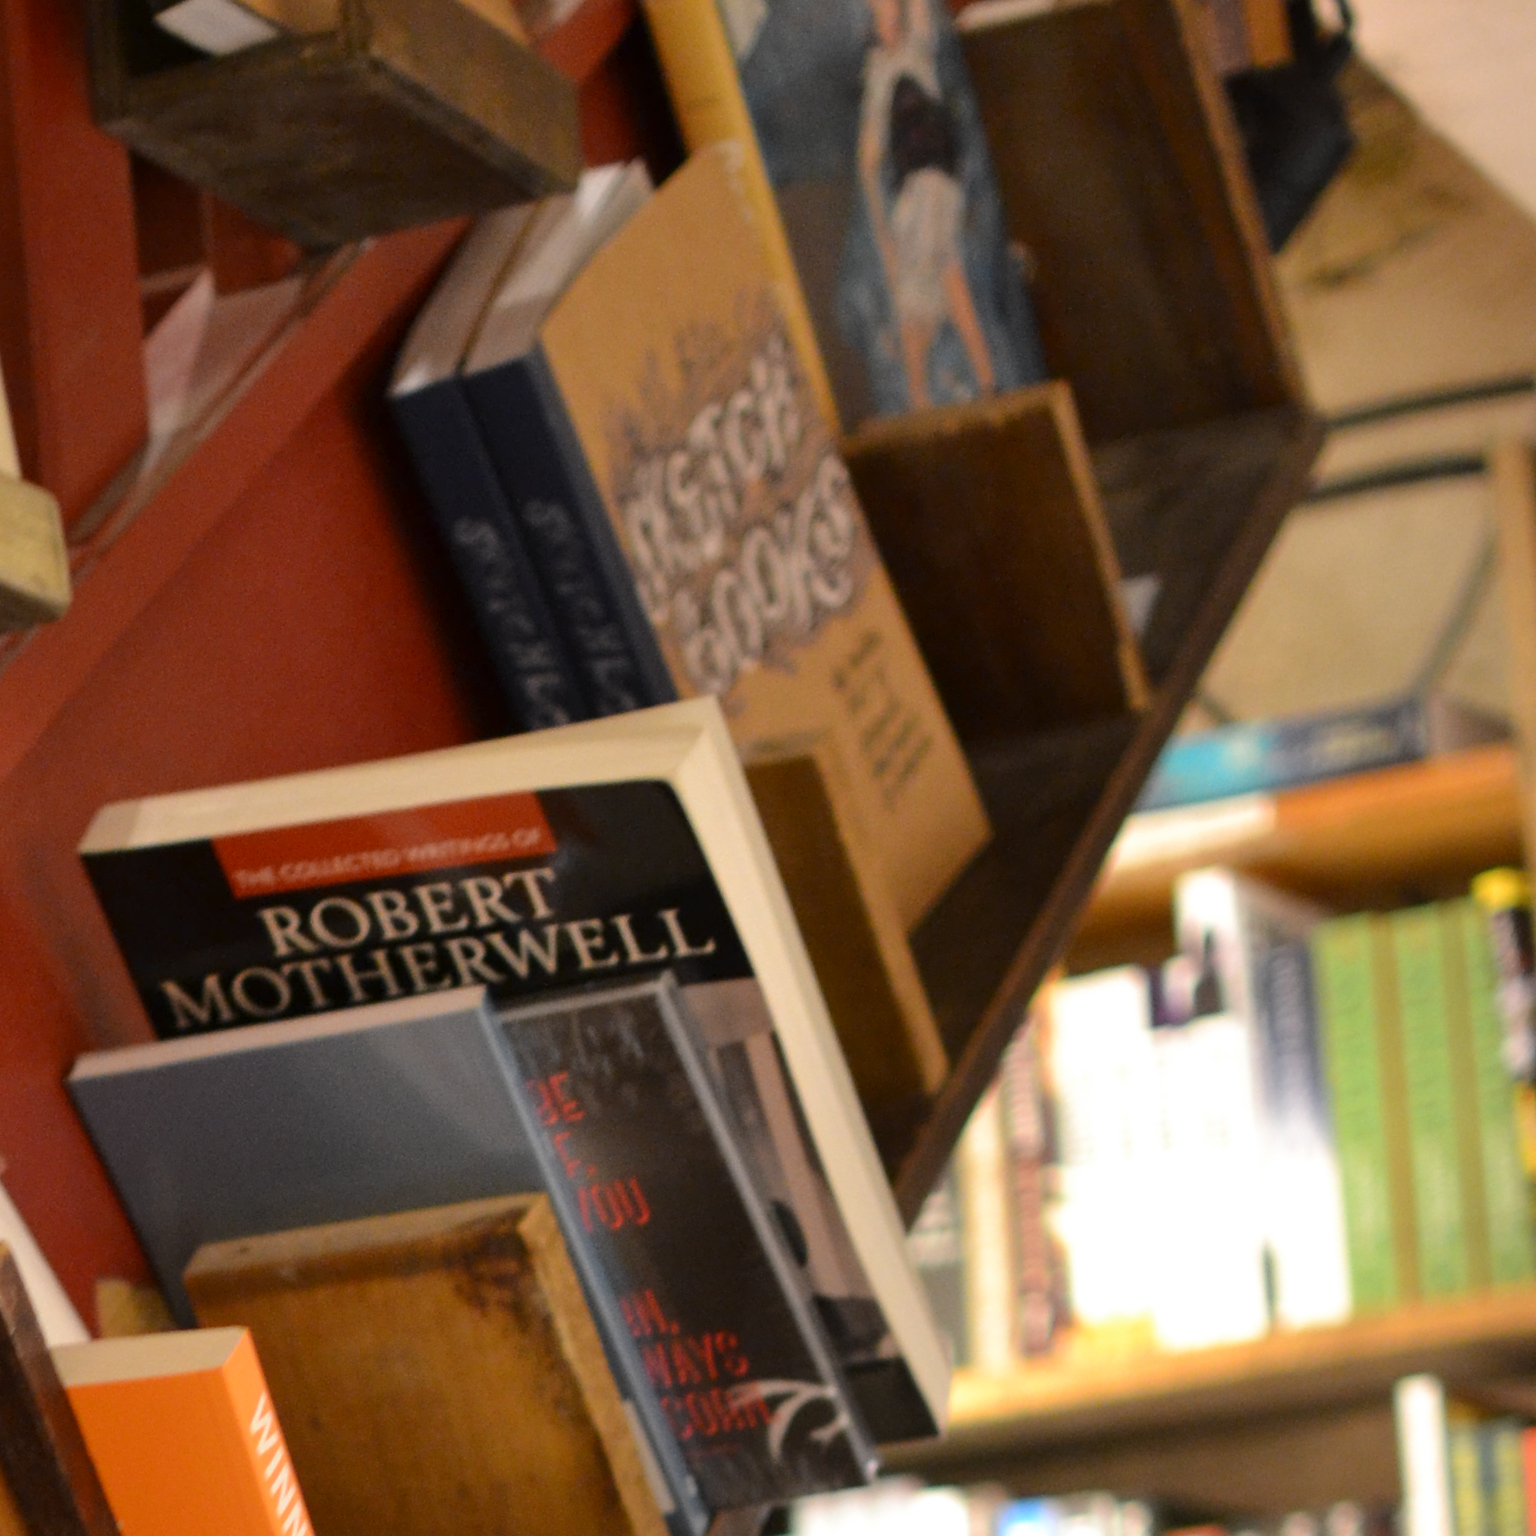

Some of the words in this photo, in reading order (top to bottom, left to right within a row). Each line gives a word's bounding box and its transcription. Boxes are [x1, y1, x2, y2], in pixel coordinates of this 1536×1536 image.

[231, 865, 275, 888] THE
[278, 850, 401, 878] COLLECTED
[405, 834, 510, 862] WRITINGS
[257, 866, 559, 958] ROBERT
[160, 906, 717, 1029] MOTHERWELL
